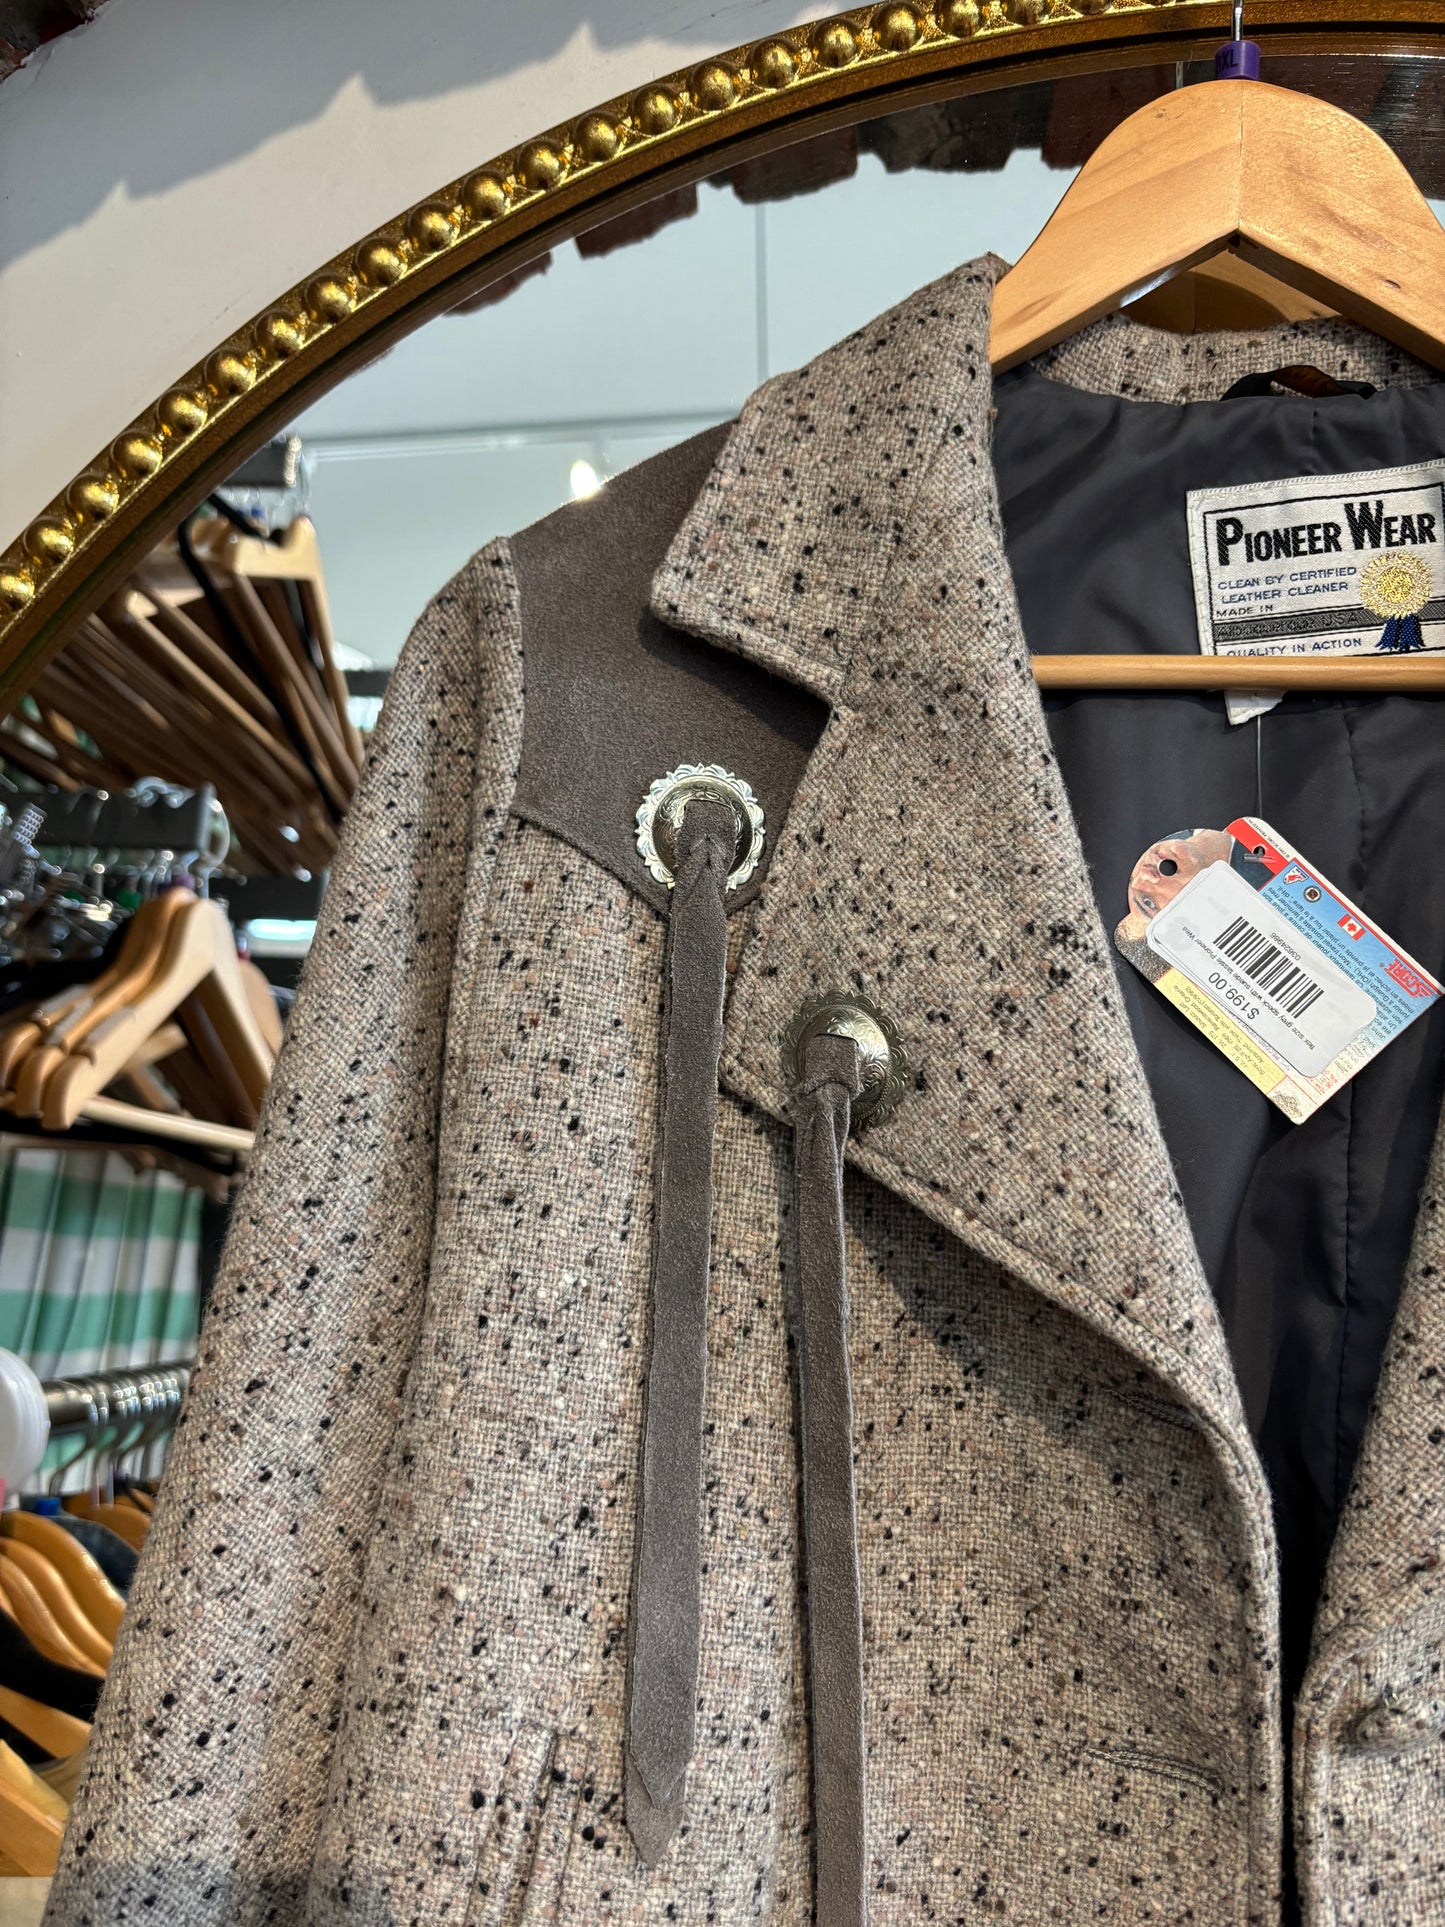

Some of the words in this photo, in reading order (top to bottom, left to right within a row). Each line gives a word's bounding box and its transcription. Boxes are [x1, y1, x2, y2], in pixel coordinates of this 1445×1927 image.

[1218, 577, 1260, 590] CLEAN
[1265, 574, 1284, 585] BY
[1289, 566, 1357, 582] CERTIFIED
[1221, 589, 1281, 604] LEATHER
[1288, 581, 1349, 597] CLEANER
[1216, 606, 1254, 618] MADE
[1260, 604, 1273, 612] IN
[1322, 610, 1359, 628] USA
[1292, 643, 1305, 653] IN
[1312, 637, 1361, 651] ACTION
[1261, 891, 1273, 903] son
[1266, 885, 1280, 899] mes
[1277, 896, 1300, 918] terminer
[1302, 909, 1310, 917] le
[1301, 919, 1324, 941] consiste
[1312, 918, 1323, 929] fou
[1320, 925, 1339, 944] plaisir
[1193, 937, 1217, 960] Pioneer
[1269, 931, 1301, 961] 03624986
[1321, 938, 1339, 955] travail
[1336, 940, 1346, 950] un
[1344, 947, 1365, 967] prends
[1361, 963, 1370, 972] je
[1367, 969, 1375, 978] et
[1231, 972, 1251, 990] suede
[1206, 970, 1260, 1021] $199.00
[1248, 987, 1263, 1002] with
[1367, 981, 1390, 1003] Guelph
[1389, 989, 1399, 999] en
[1261, 998, 1280, 1017] speck
[1391, 1002, 1410, 1020] junior
[1396, 996, 1415, 1014] mises
[1278, 1013, 1293, 1028] grey
[1386, 1019, 1397, 1030] Un
[1290, 1026, 1305, 1040] size
[1370, 1025, 1386, 1040] John
